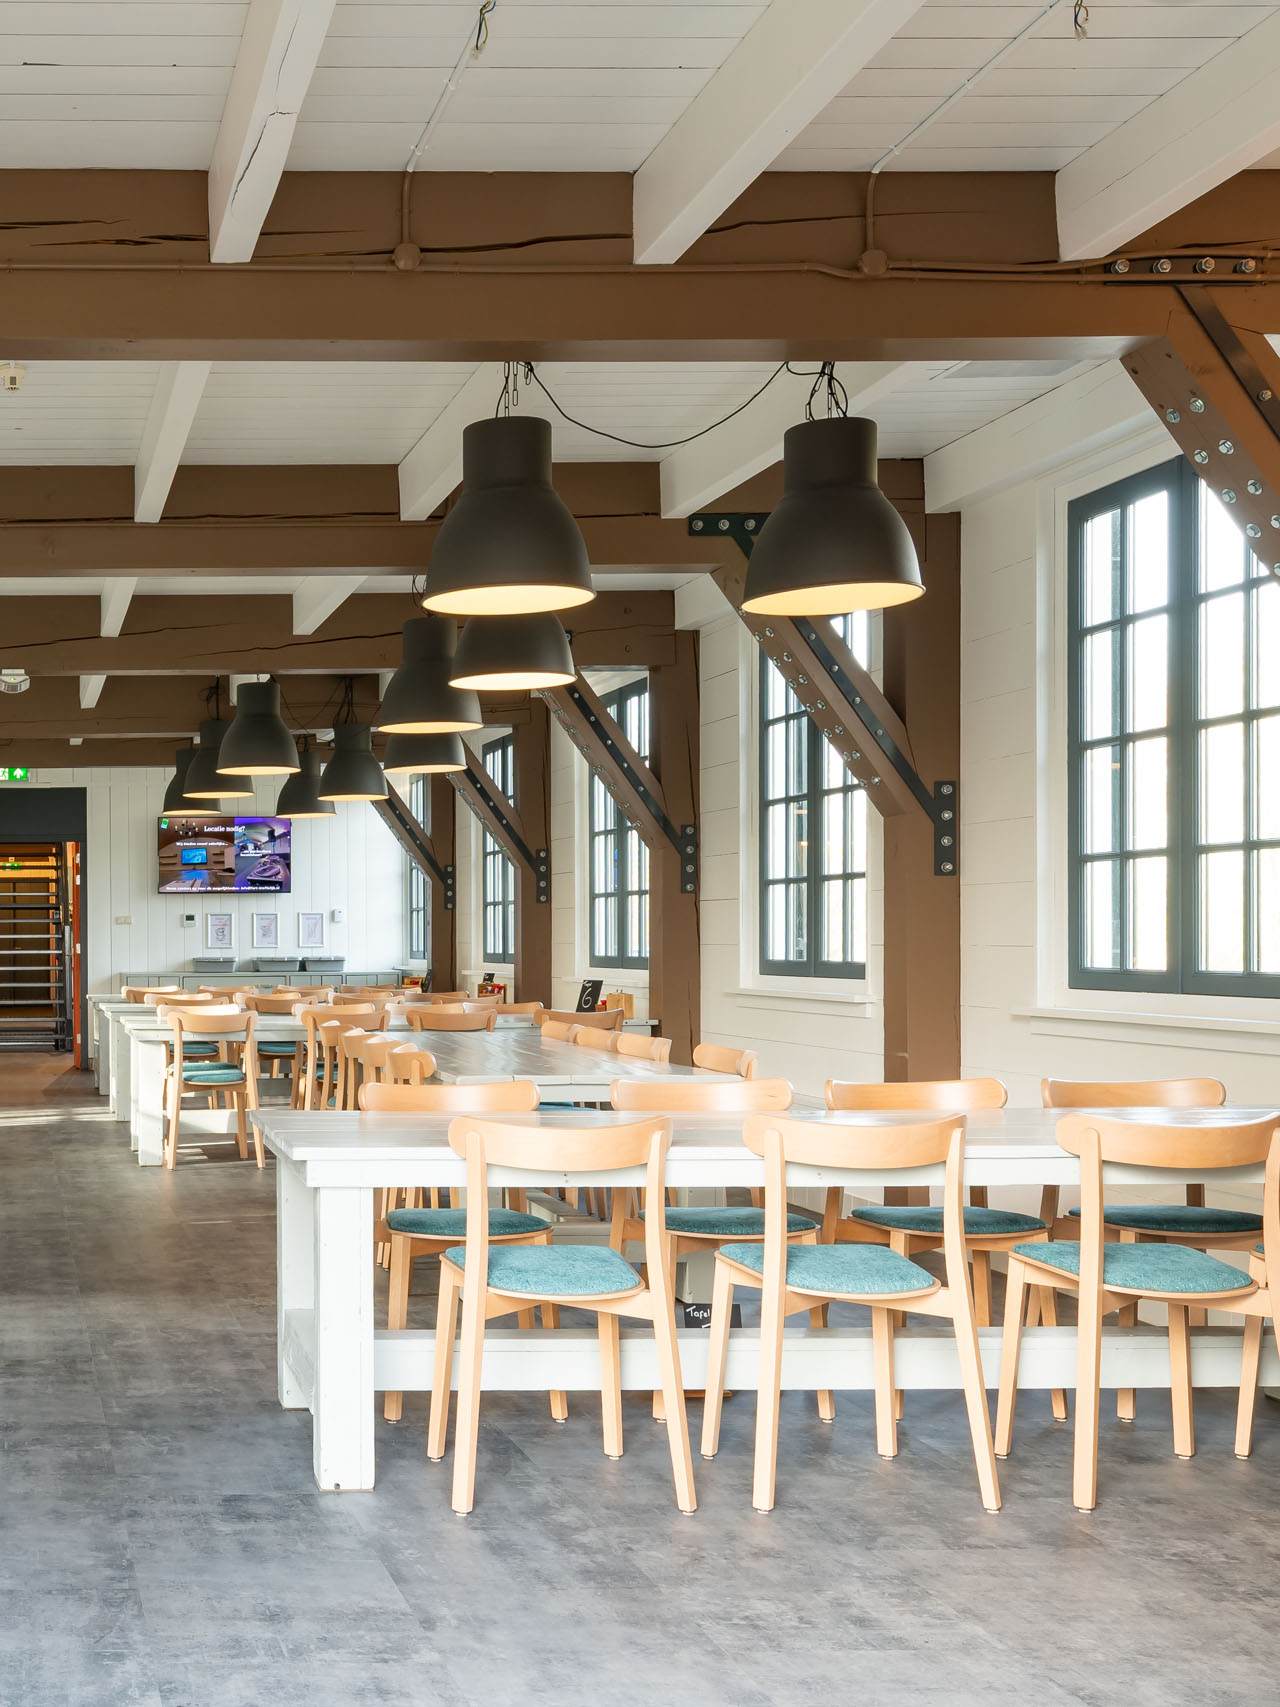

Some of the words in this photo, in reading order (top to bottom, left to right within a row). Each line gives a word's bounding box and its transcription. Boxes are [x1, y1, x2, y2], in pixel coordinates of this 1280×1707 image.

[226, 825, 245, 833] nodig?
[582, 988, 592, 1008] 6
[686, 1305, 710, 1319] Tafel
